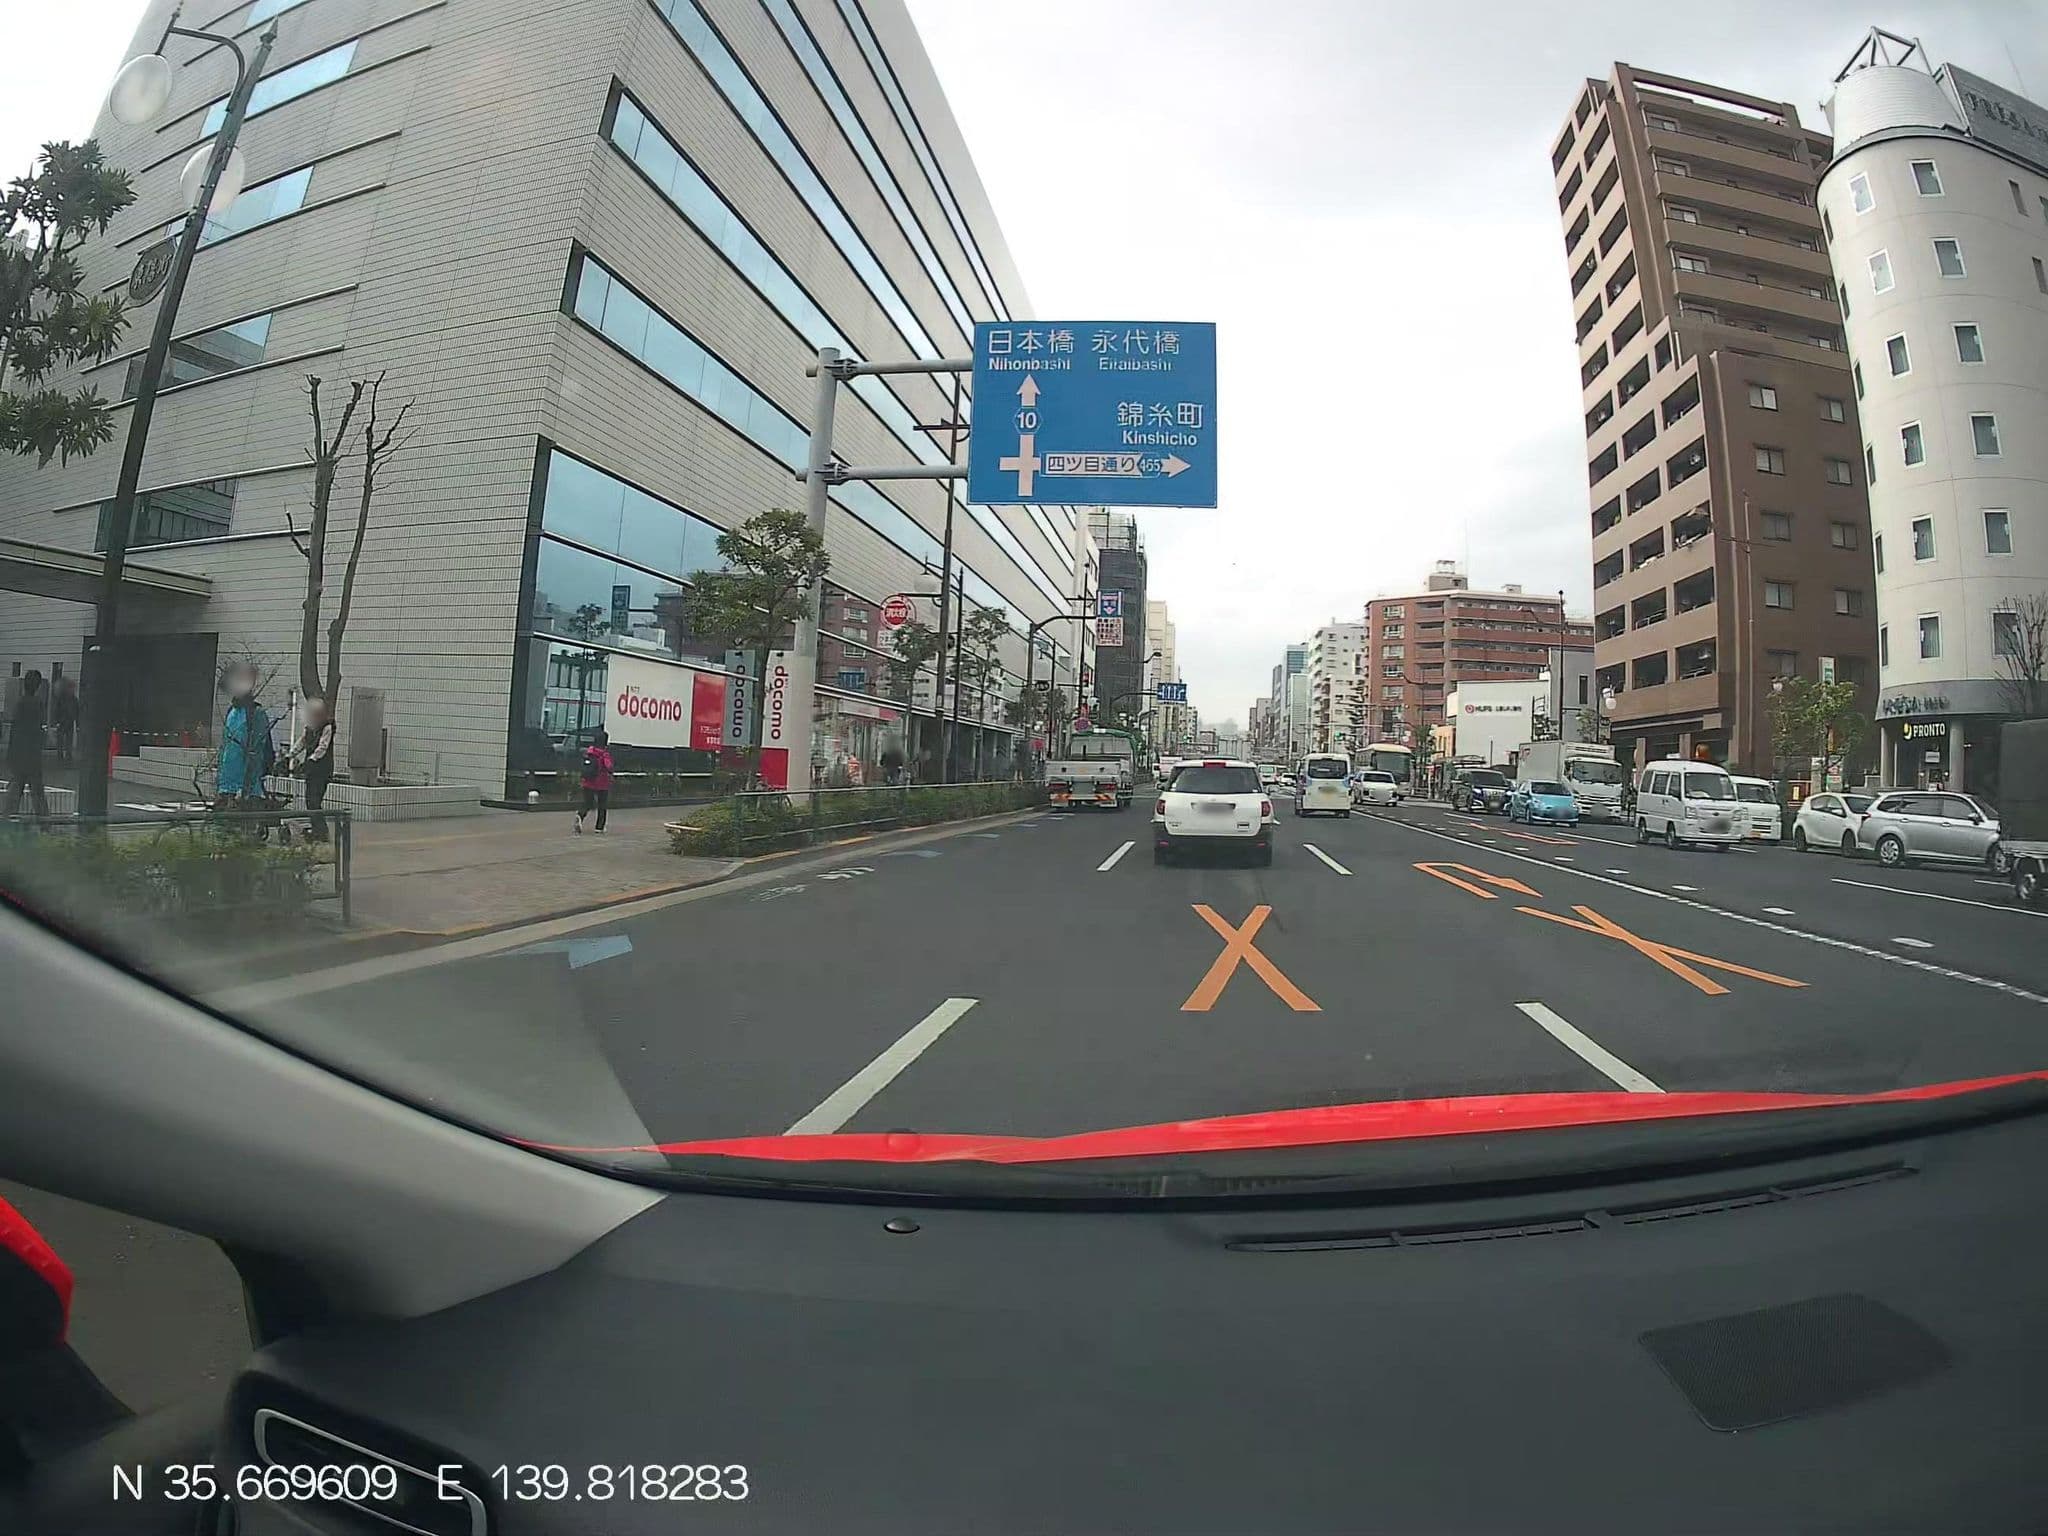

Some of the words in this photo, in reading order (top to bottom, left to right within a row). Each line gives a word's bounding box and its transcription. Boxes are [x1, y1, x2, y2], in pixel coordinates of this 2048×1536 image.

[988, 329, 1074, 354] 日本橋
[1092, 329, 1180, 354] 永代橋
[989, 357, 1071, 370] Nihonbashi
[1099, 357, 1173, 371] Eitaibashi
[1017, 411, 1037, 429] 10
[1117, 401, 1203, 428] 錦糸町
[1122, 430, 1198, 446] Kinshicho
[1047, 456, 1135, 473] 四ツ目通り
[1139, 458, 1161, 472] 465
[617, 684, 682, 721] docomo
[771, 665, 789, 740] docomo
[1912, 723, 1946, 737] PRONTO
